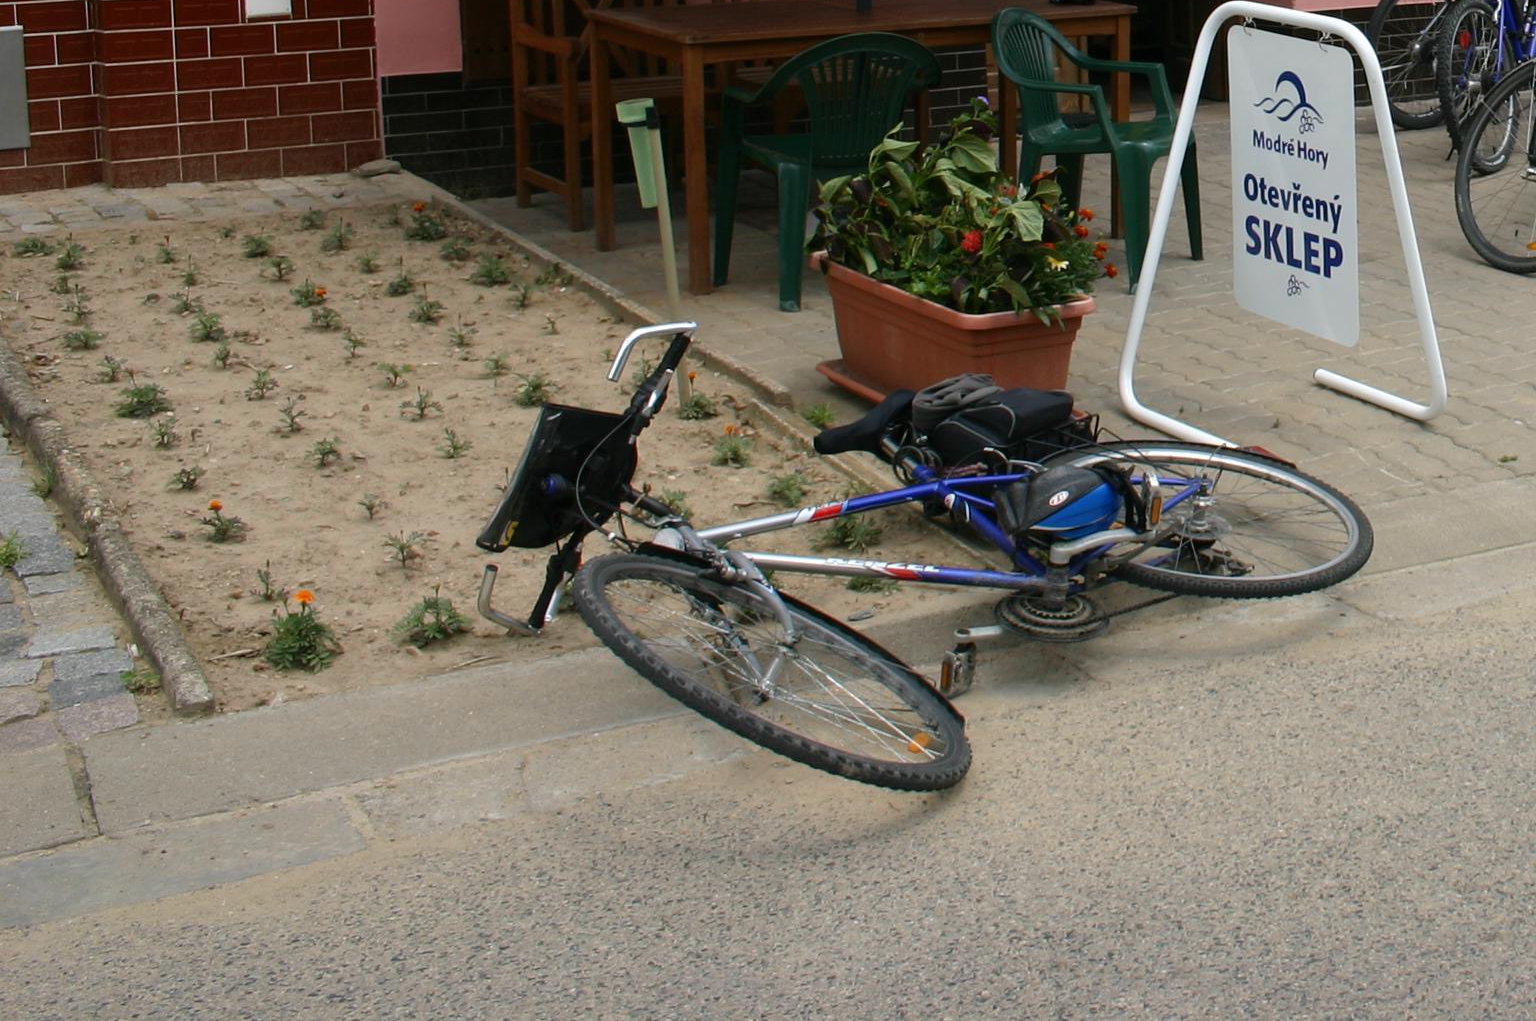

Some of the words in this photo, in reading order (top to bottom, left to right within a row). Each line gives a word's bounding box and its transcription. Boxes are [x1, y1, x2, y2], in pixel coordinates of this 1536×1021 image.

[1252, 129, 1295, 157] Modré
[1297, 139, 1329, 170] Hory
[1243, 173, 1342, 234] Otevřený
[1245, 215, 1344, 279] SKLEP
